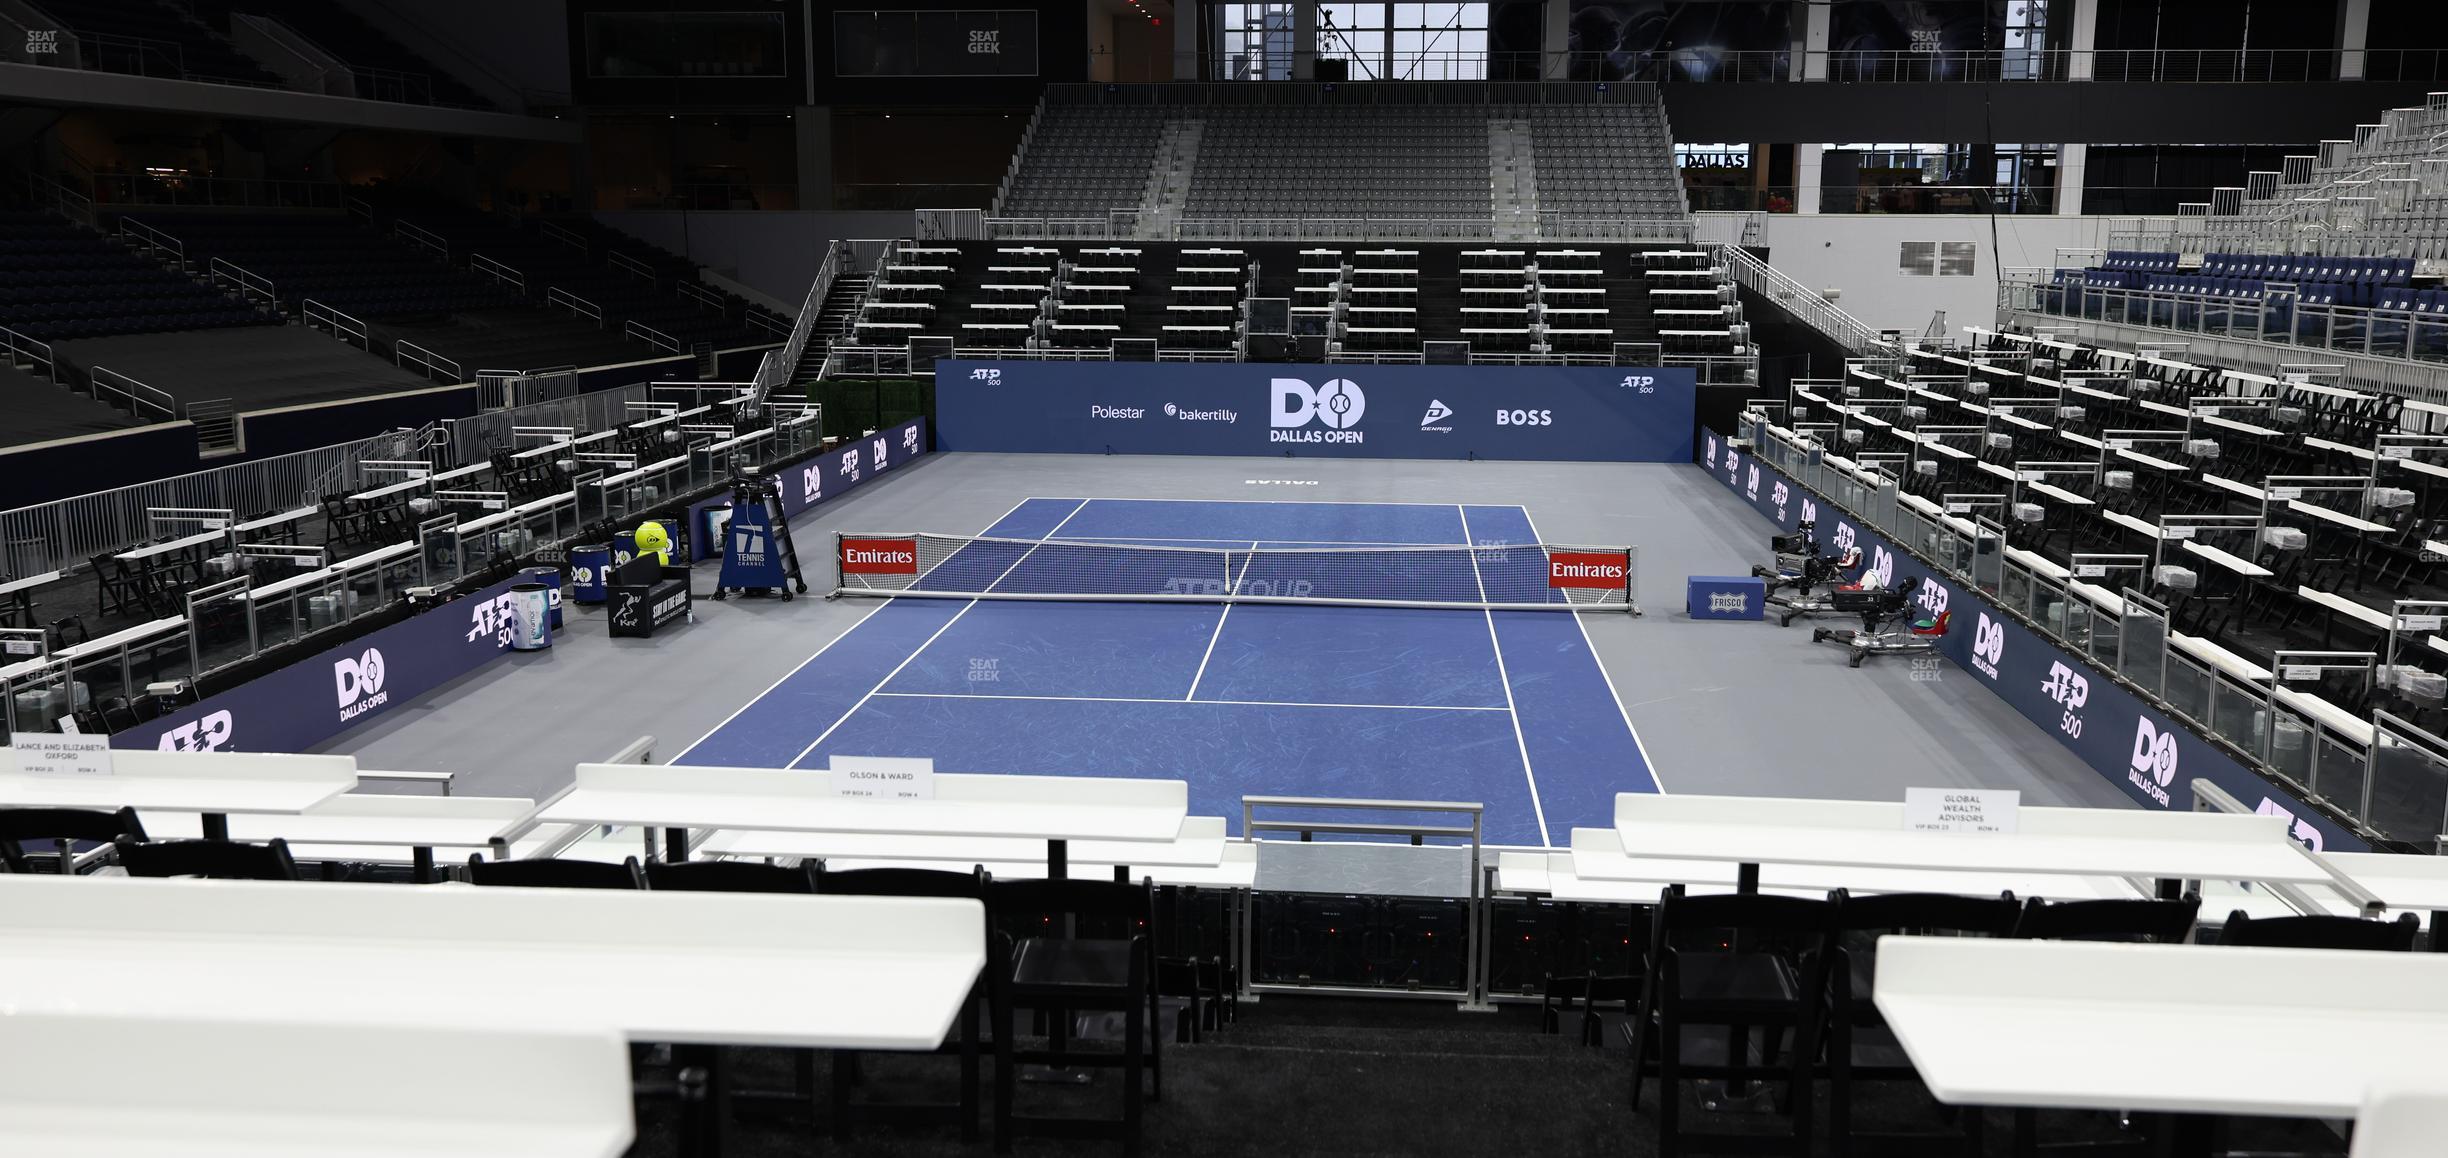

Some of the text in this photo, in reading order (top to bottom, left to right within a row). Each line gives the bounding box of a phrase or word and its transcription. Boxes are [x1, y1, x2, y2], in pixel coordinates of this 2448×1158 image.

[1686, 154, 1744, 168] DALLAS
[968, 368, 1001, 380] ATP
[1621, 376, 1654, 387] ATP
[1270, 378, 1366, 429] DO
[1091, 405, 1145, 419] Polestar
[1179, 408, 1238, 424] bakertilly
[1496, 409, 1552, 426] BOSS
[903, 425, 918, 448] ATP
[1270, 430, 1364, 444] DALLAS OPEN
[840, 449, 859, 476] ATP
[1725, 450, 1739, 471] ATP
[851, 467, 860, 482] 500
[1771, 481, 1789, 507] ATP
[1833, 521, 1855, 553] ATP
[737, 553, 765, 562] TENNIS
[846, 548, 913, 564] Emirates
[1552, 562, 1622, 578] Emirates
[1714, 598, 1741, 607] FRISCO
[1917, 577, 1948, 616] ATP
[1974, 611, 2004, 665] DO
[334, 647, 385, 709] DO
[2041, 660, 2089, 711] ATP
[340, 690, 388, 722] DALLAS OPEN
[2060, 711, 2082, 739] 500
[45, 752, 78, 760] OXFORD
[2131, 714, 2178, 787] DO
[850, 771, 878, 779] OLSON
[881, 772, 886, 780] &
[2128, 767, 2170, 808] DALLAS OPEN
[1945, 795, 1981, 803] GLOBAL
[1943, 804, 1981, 812] WEALTH
[1939, 814, 1984, 822] ADVISORS
